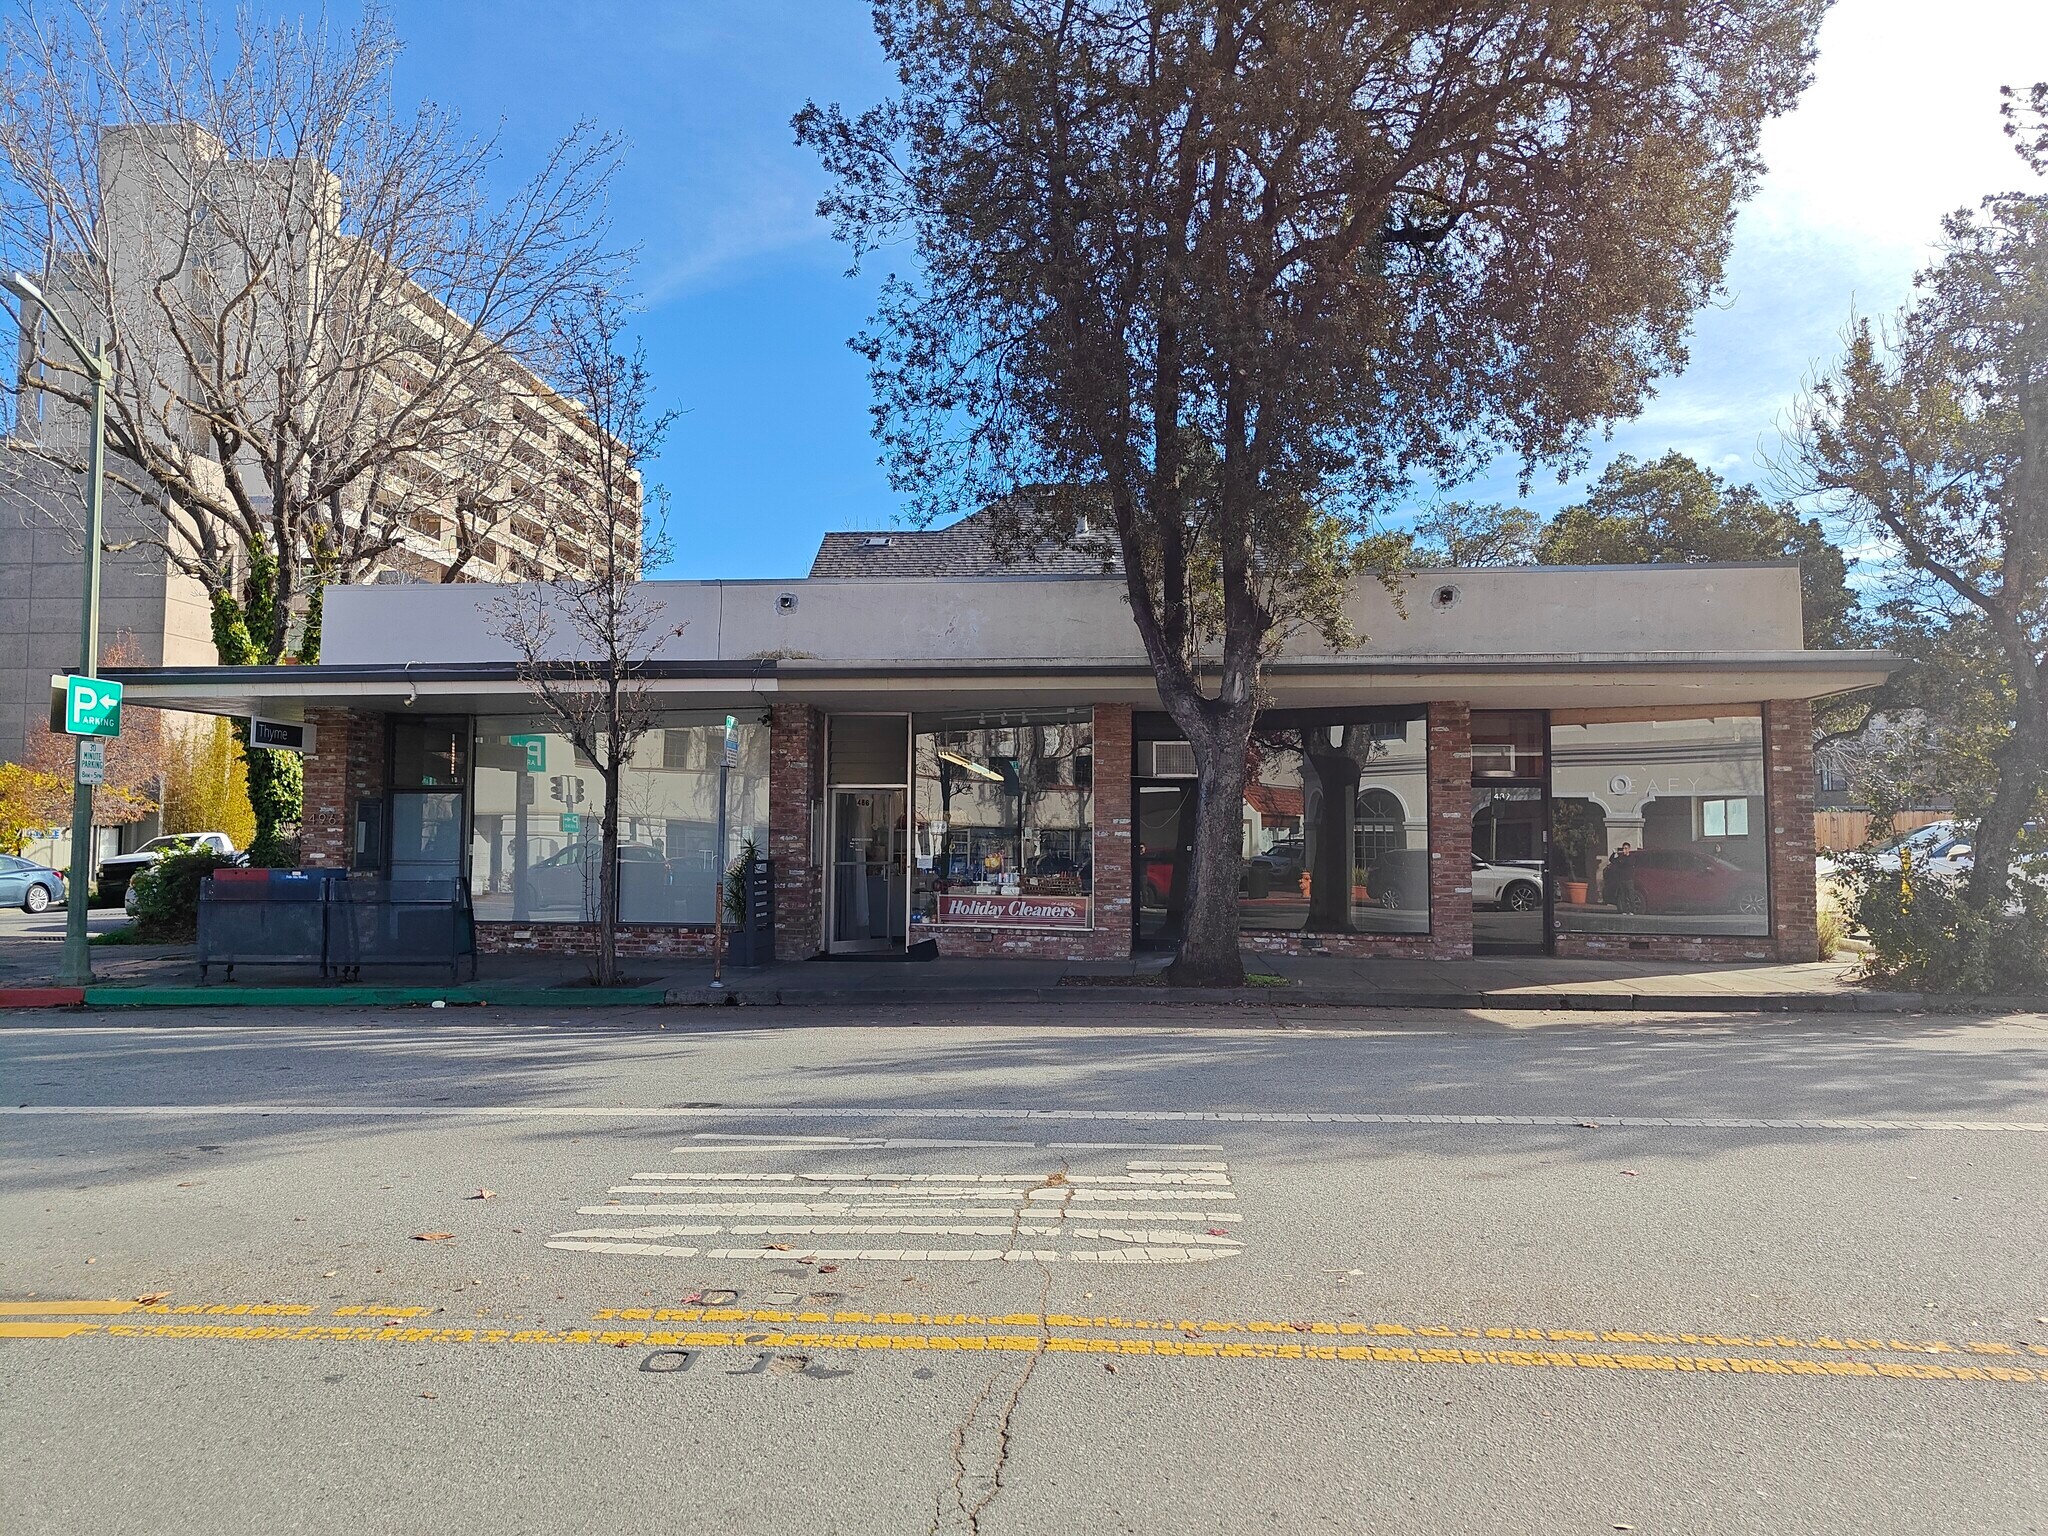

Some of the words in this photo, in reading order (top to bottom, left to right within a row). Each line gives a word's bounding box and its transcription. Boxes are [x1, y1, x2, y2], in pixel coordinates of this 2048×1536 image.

[259, 724, 288, 741] Thyme
[90, 743, 97, 752] 30
[83, 751, 102, 761] MINUTE
[81, 759, 103, 769] PARKING
[1606, 776, 1701, 795] LEAFY
[308, 813, 336, 825] 496
[948, 900, 1006, 919] Holiday
[1008, 900, 1076, 918] Cleaners
